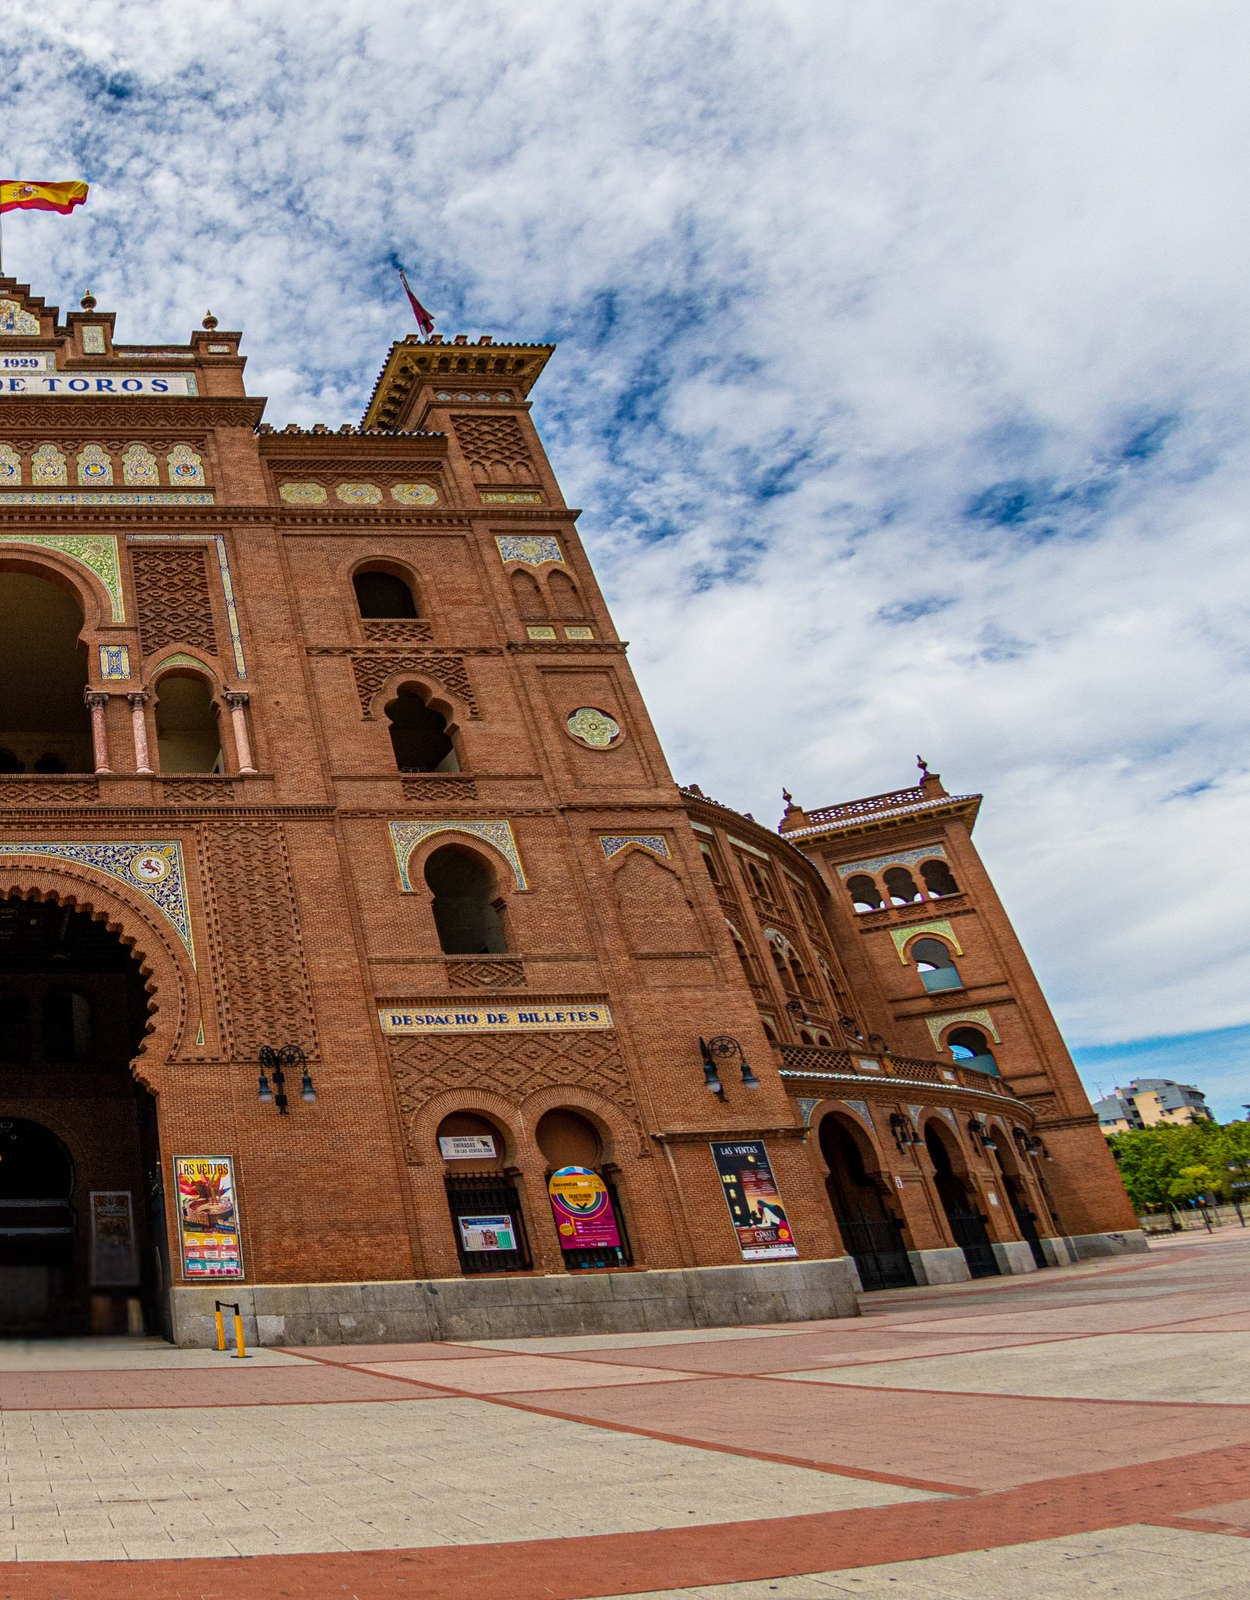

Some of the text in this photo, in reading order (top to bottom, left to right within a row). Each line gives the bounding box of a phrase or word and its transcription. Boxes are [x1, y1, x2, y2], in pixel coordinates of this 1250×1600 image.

[3, 358, 39, 368] 1929
[41, 378, 169, 392] TOROS
[391, 1010, 600, 1026] DESPACHO DE BILLETES
[720, 1145, 758, 1155] LAS VENTAS
[179, 1163, 195, 1175] LAS
